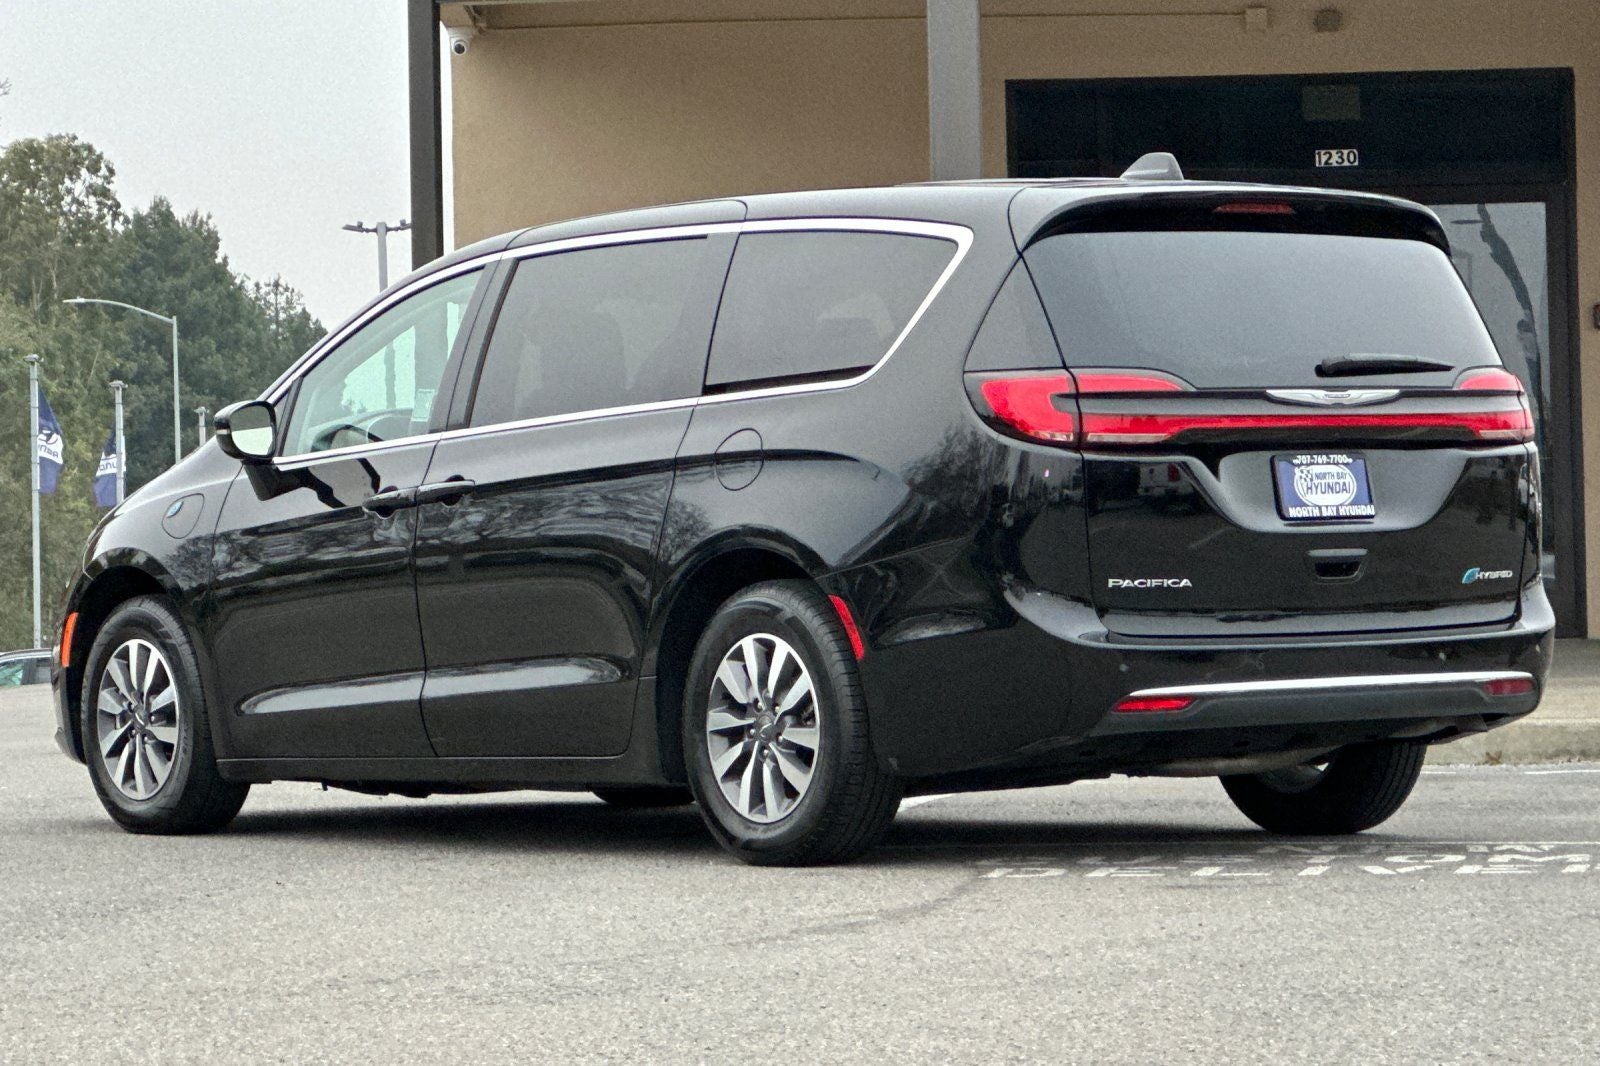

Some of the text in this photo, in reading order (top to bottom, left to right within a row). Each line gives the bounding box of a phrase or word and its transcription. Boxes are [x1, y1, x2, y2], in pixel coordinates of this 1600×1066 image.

[1316, 150, 1357, 166] 1230
[1314, 471, 1348, 480] NORTH BAY
[1306, 481, 1351, 495] HYUNDAI
[1288, 504, 1375, 518] NORTH BAY HYUNDAI
[1107, 578, 1193, 588] PACIFICA
